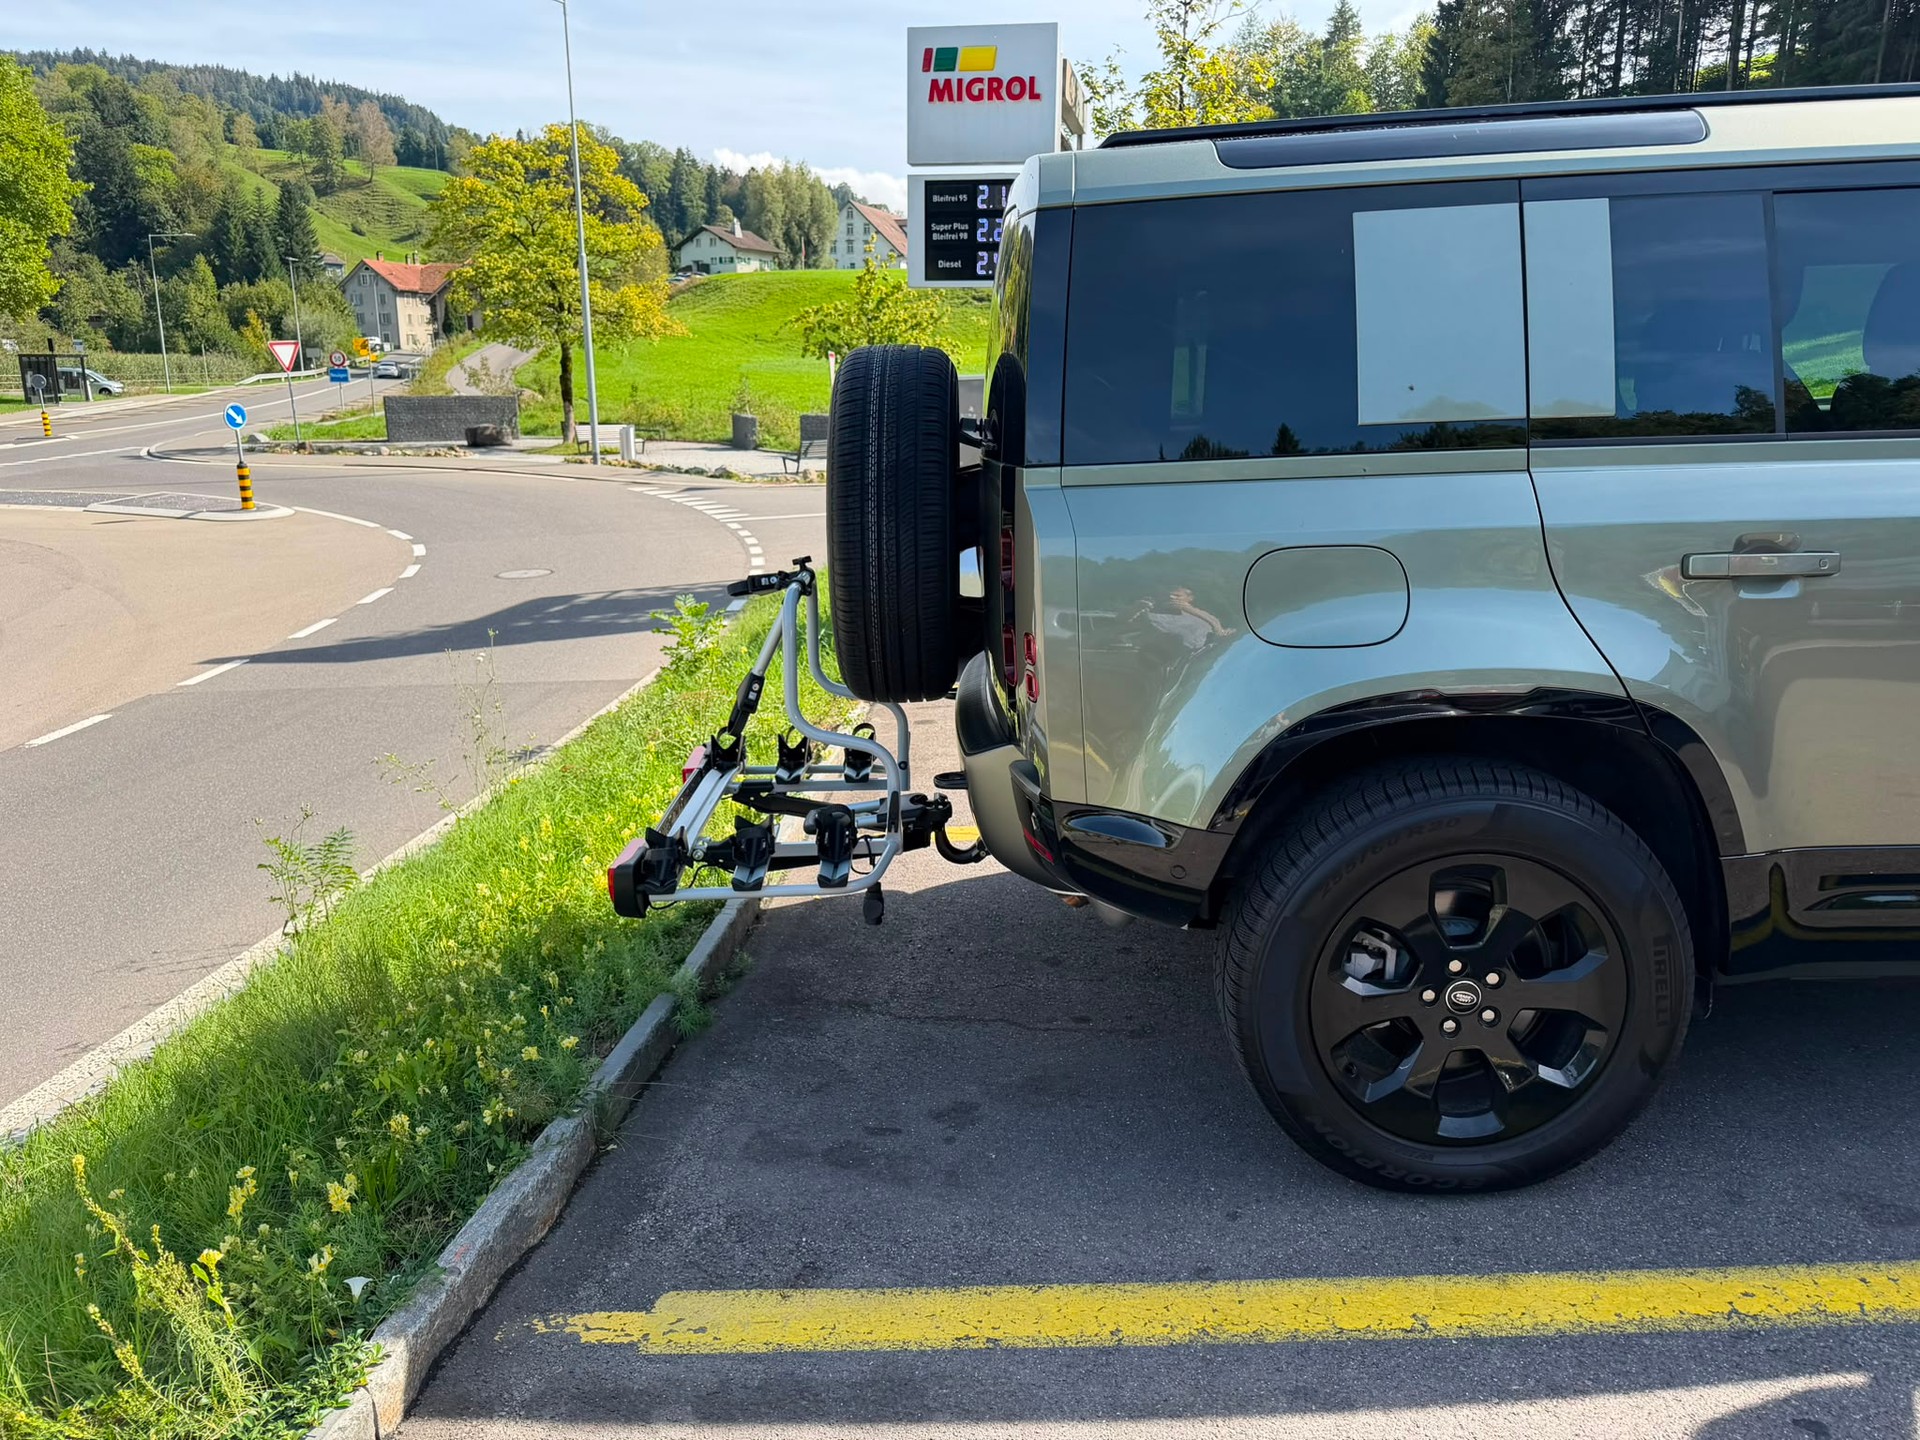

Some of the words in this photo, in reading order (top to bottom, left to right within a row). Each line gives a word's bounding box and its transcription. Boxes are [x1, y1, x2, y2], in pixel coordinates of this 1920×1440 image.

[928, 76, 1042, 103] MIGROL
[932, 194, 958, 202] Bleifrei
[959, 194, 968, 202] 95
[931, 223, 952, 231] Super
[953, 223, 969, 231] Plus
[932, 233, 958, 241] Bleifrei
[959, 232, 969, 240] 98
[938, 260, 962, 268] Diesel
[1652, 934, 1676, 1028] PIRELLI
[1304, 1114, 1486, 1189] SCORPION
